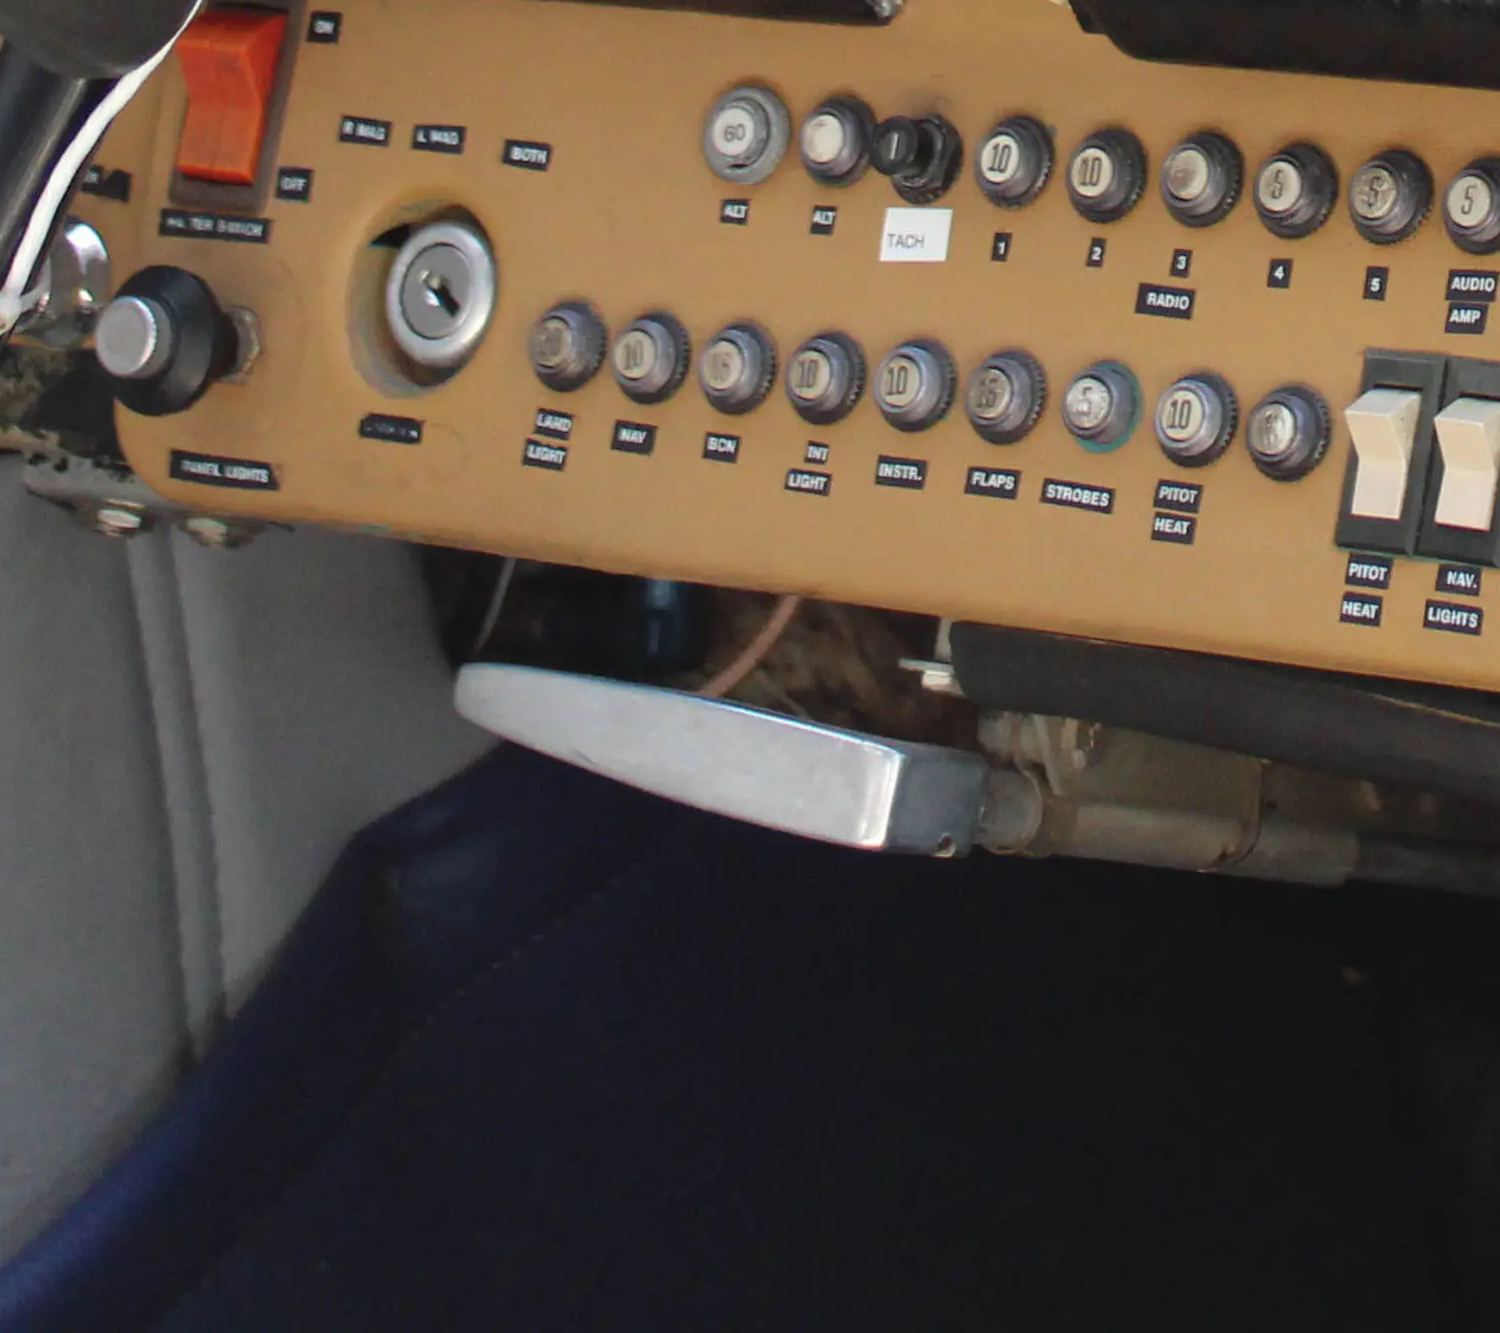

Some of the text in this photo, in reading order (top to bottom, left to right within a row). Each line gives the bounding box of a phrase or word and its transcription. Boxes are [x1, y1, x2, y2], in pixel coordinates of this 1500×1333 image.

[724, 123, 747, 142] 60
[887, 234, 925, 249] TACH
[1451, 275, 1496, 293] AUDIO
[1147, 292, 1190, 310] RADIO
[1449, 307, 1481, 325] AMP
[620, 427, 647, 445] NAV
[879, 463, 923, 480] INSTR.
[787, 473, 827, 492] LIGHT
[971, 471, 1015, 491] FLAPS
[1046, 484, 1110, 507] STROBES
[1159, 486, 1198, 505] PITOT
[1154, 517, 1190, 535] HEAT
[1348, 563, 1388, 583] PITOT
[1342, 601, 1379, 619] HEAT
[1428, 606, 1478, 628] LIGHTS
